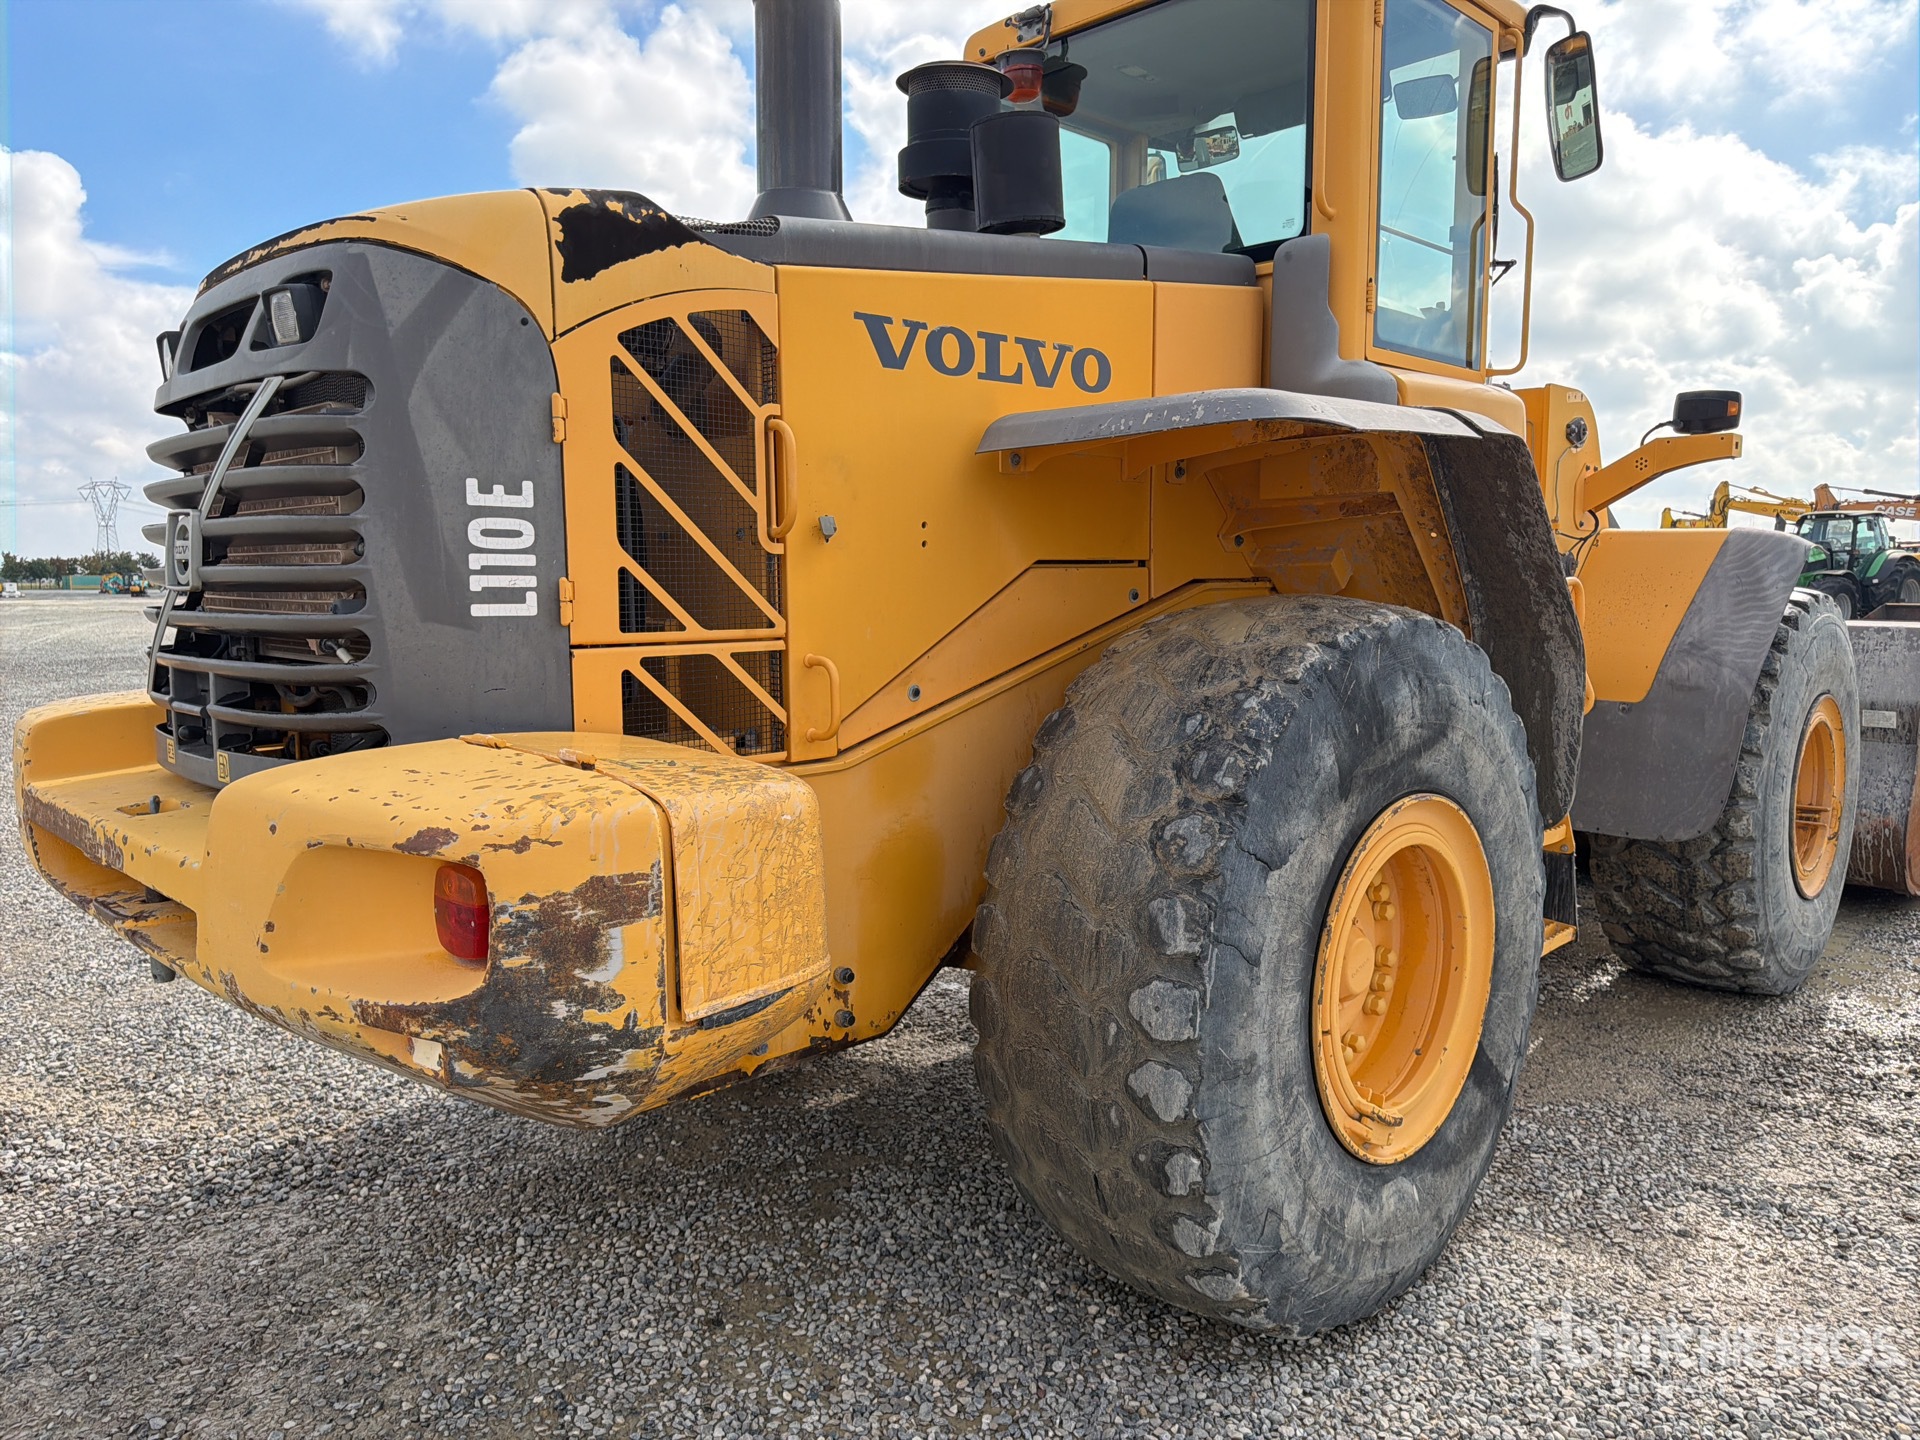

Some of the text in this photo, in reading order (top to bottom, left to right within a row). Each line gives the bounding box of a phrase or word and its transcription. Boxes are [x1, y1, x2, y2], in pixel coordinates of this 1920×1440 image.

[853, 311, 1112, 393] VOLVO
[465, 477, 538, 617] L110E
[1874, 505, 1917, 516] CASE
